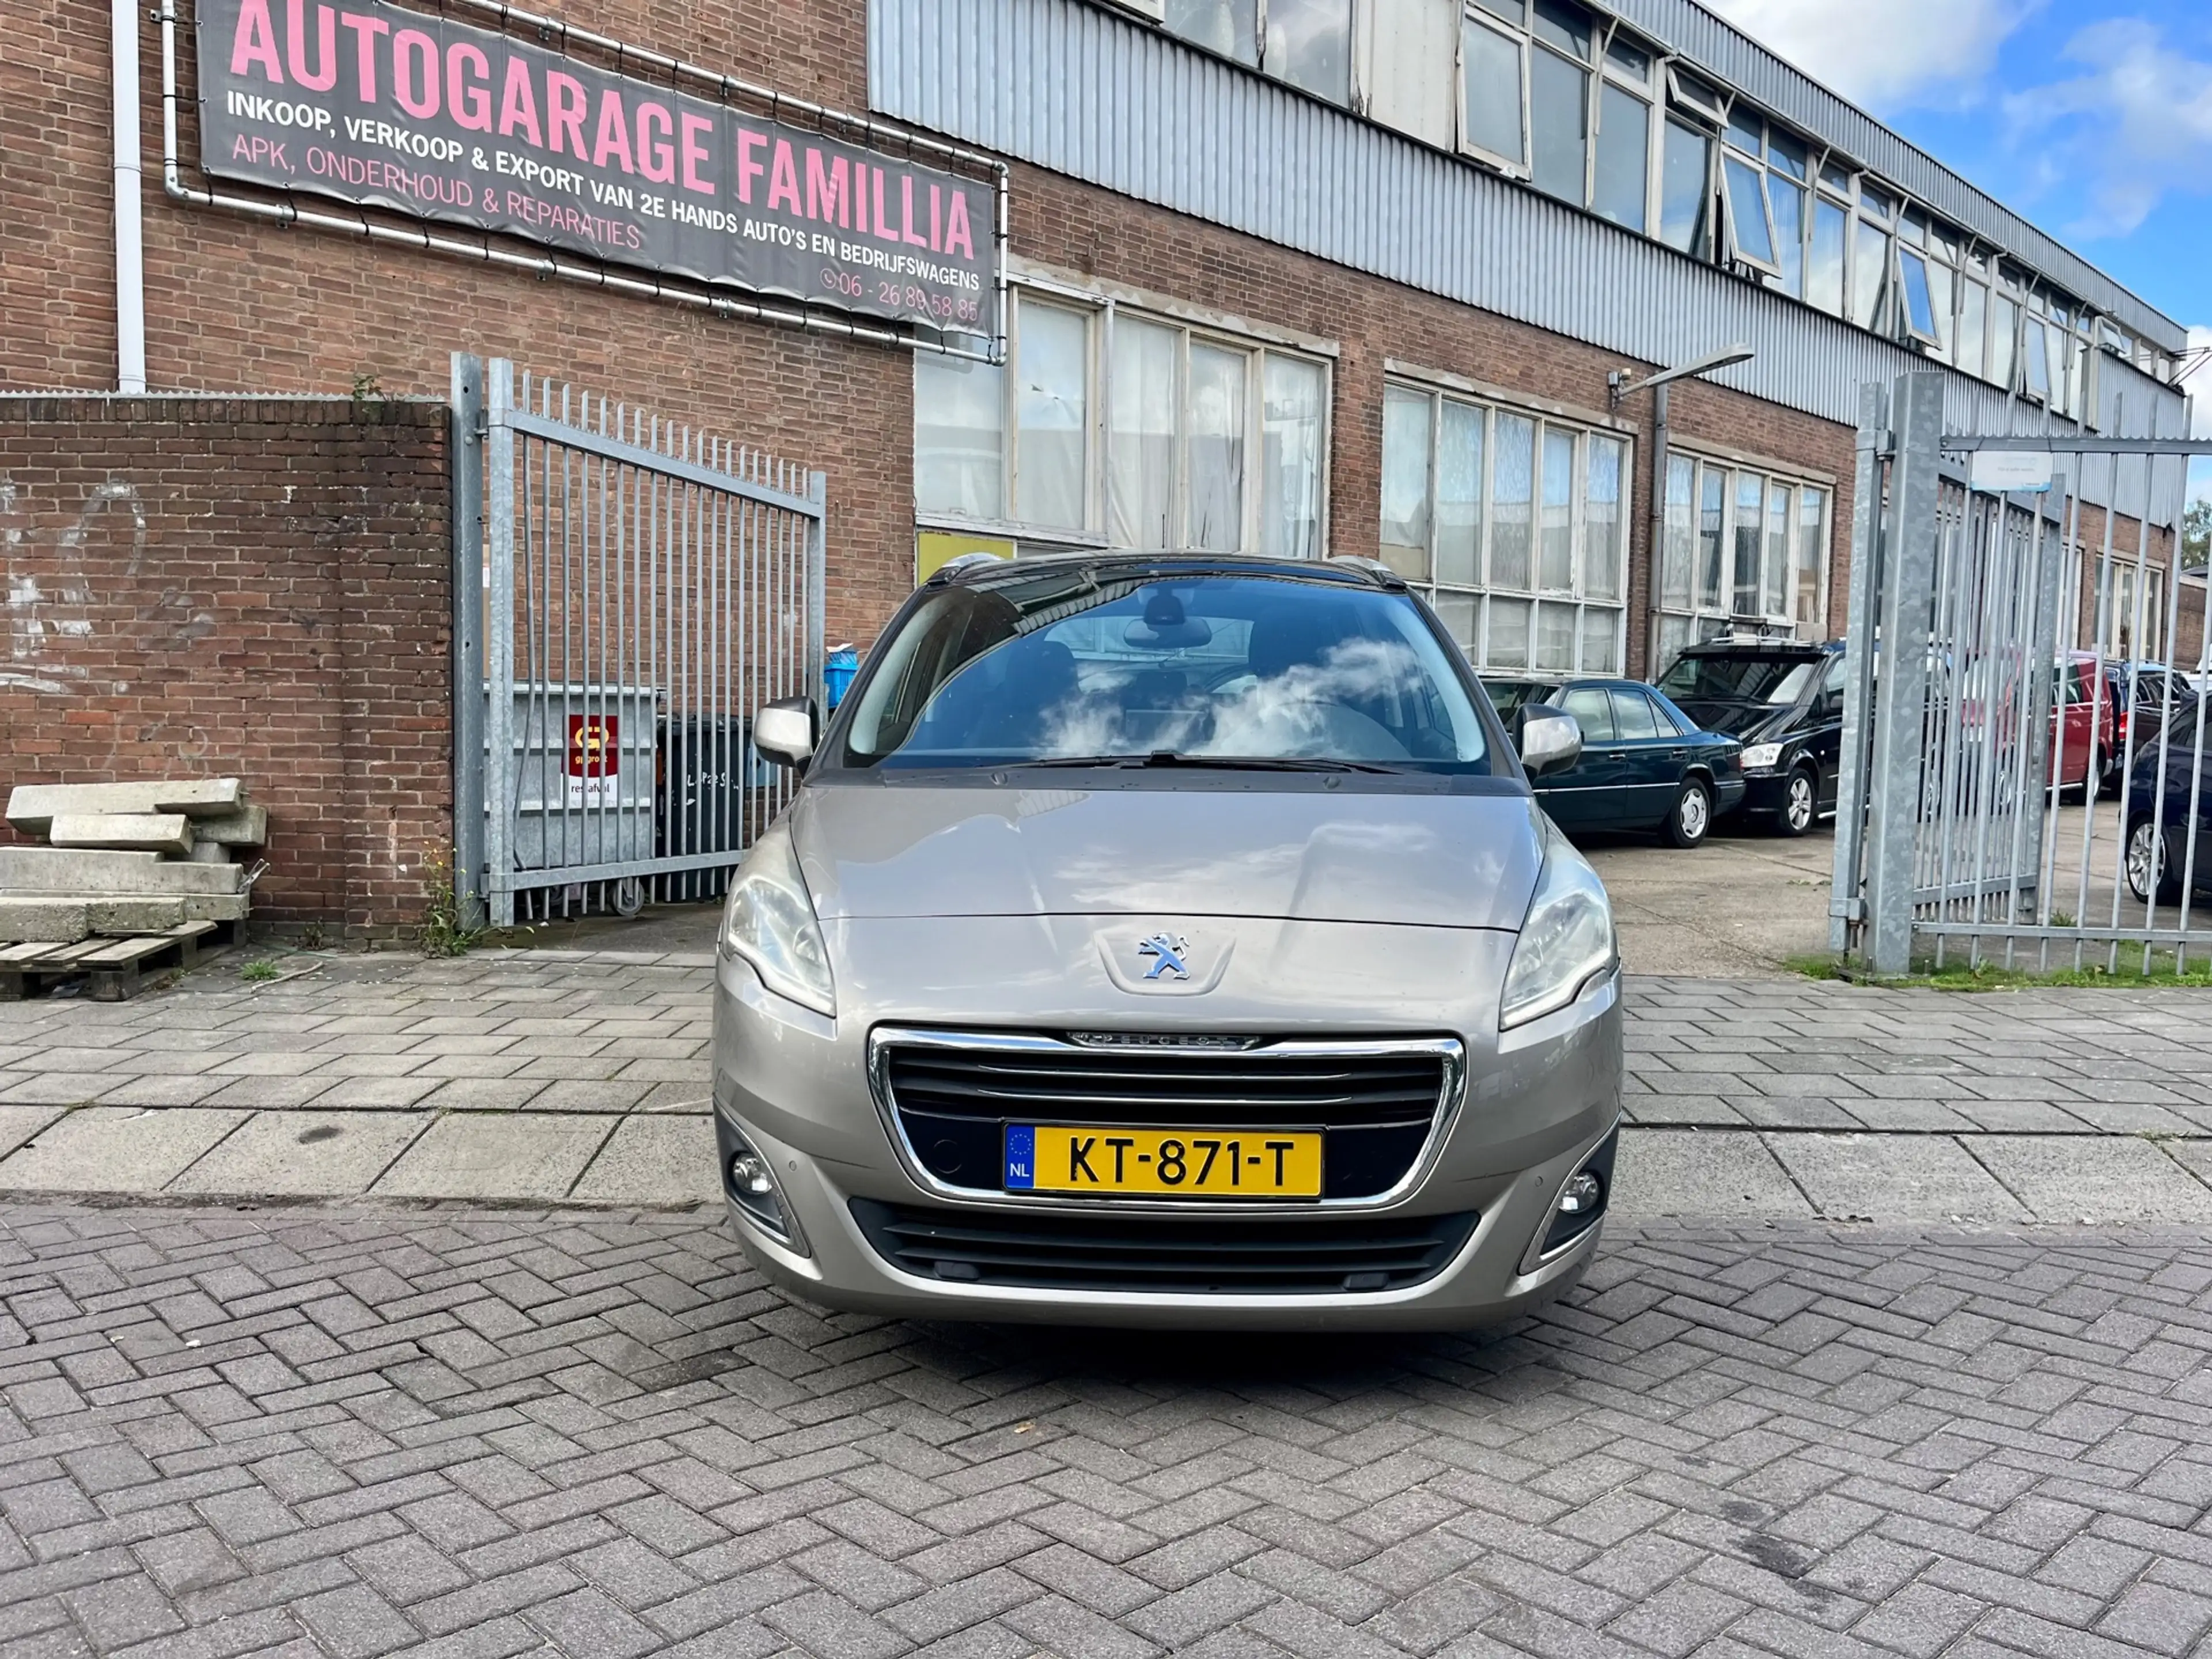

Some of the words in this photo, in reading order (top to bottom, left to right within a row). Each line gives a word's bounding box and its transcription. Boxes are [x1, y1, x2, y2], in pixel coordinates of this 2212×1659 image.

[230, 0, 715, 195] AUTOGARAGE
[737, 128, 974, 260] FAMILLIA
[228, 90, 336, 139] INKOOP,
[344, 115, 464, 162] VERKOOP
[471, 146, 489, 171] &
[496, 150, 584, 196] EXPORT
[590, 179, 633, 210] VAN
[640, 194, 665, 218] 2E
[672, 200, 738, 234] HANDS
[743, 219, 806, 251] AUTO'S
[812, 233, 835, 257] EN
[841, 242, 979, 291] BEDRIJFSWAGENS
[233, 134, 296, 175] APK,
[306, 146, 473, 207] ONDERHOUD
[482, 187, 499, 214] &
[507, 190, 640, 249] REPARATIES
[839, 272, 862, 297] 06
[878, 281, 900, 306] 26
[906, 286, 926, 309] 89
[932, 293, 952, 316] 58
[958, 298, 978, 321] 85
[571, 783, 610, 793] resafvl
[1102, 1034, 1229, 1047] PEUGEOT
[1010, 1163, 1030, 1177] NL
[1070, 1136, 1294, 1186] KT-871-T
